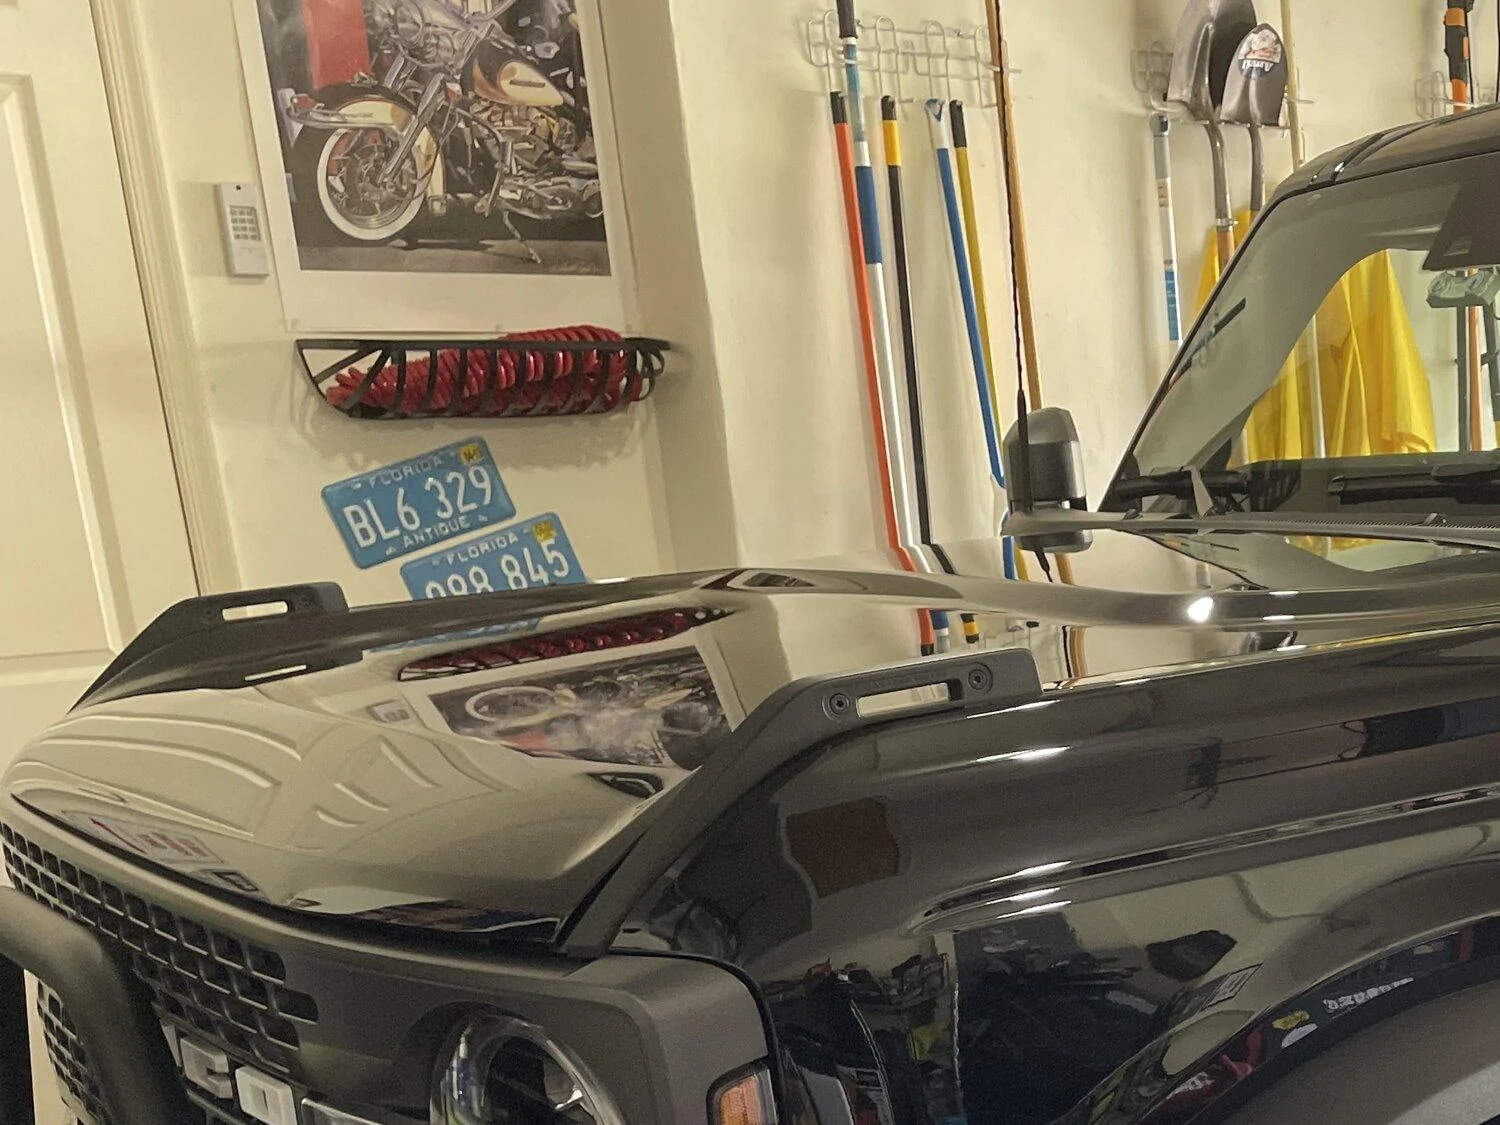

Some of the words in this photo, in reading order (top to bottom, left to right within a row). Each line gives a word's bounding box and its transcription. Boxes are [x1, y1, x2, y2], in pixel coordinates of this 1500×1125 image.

[369, 456, 443, 489] FLORIDA
[342, 487, 421, 549] BL6
[425, 466, 492, 520] 329
[403, 516, 471, 548] ANTIQUE
[446, 532, 519, 565] FLORIDA
[501, 539, 570, 590] 845
